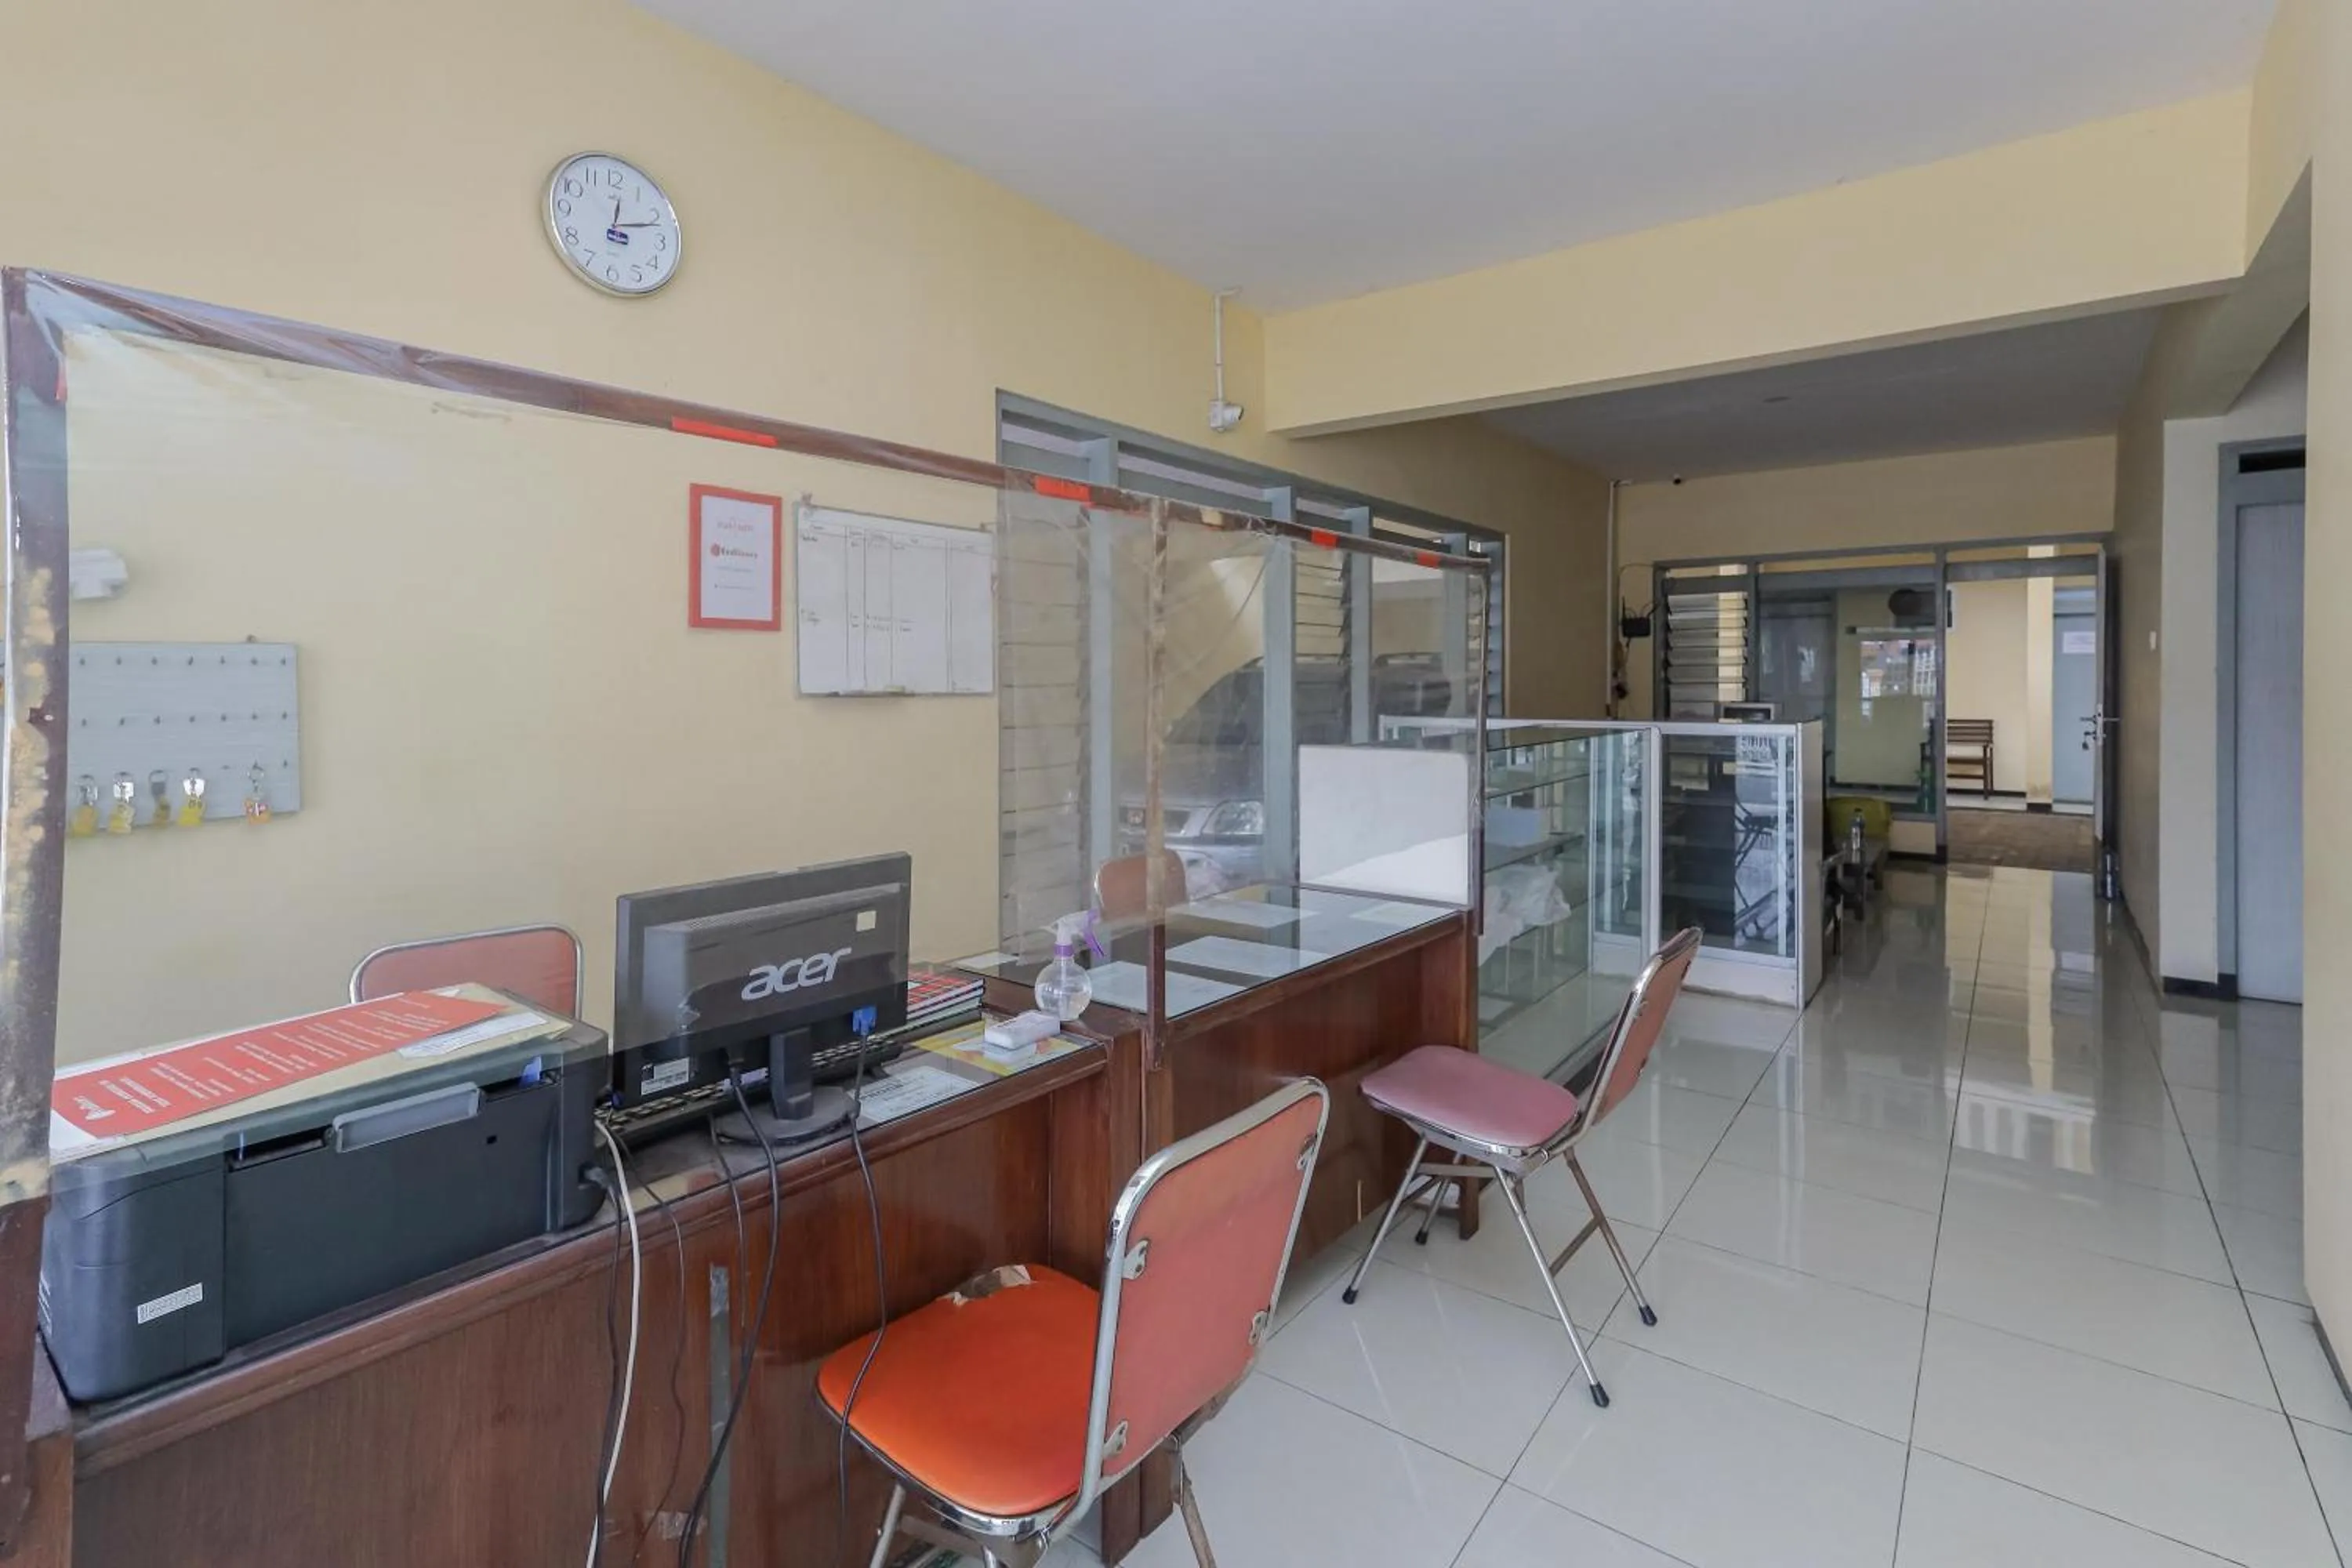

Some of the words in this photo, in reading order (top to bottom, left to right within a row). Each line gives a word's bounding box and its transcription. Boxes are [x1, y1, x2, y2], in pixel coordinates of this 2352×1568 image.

[586, 167, 597, 187] 11
[608, 169, 623, 190] 12
[564, 177, 583, 198] 10
[636, 186, 641, 202] 1
[557, 198, 572, 217] 9
[649, 207, 660, 225] 2
[565, 226, 579, 245] 8
[654, 233, 666, 252] 3
[583, 249, 596, 267] 7
[646, 254, 658, 270] 4
[606, 265, 619, 283] 6
[630, 264, 642, 283] 5
[741, 947, 852, 1000] acer
